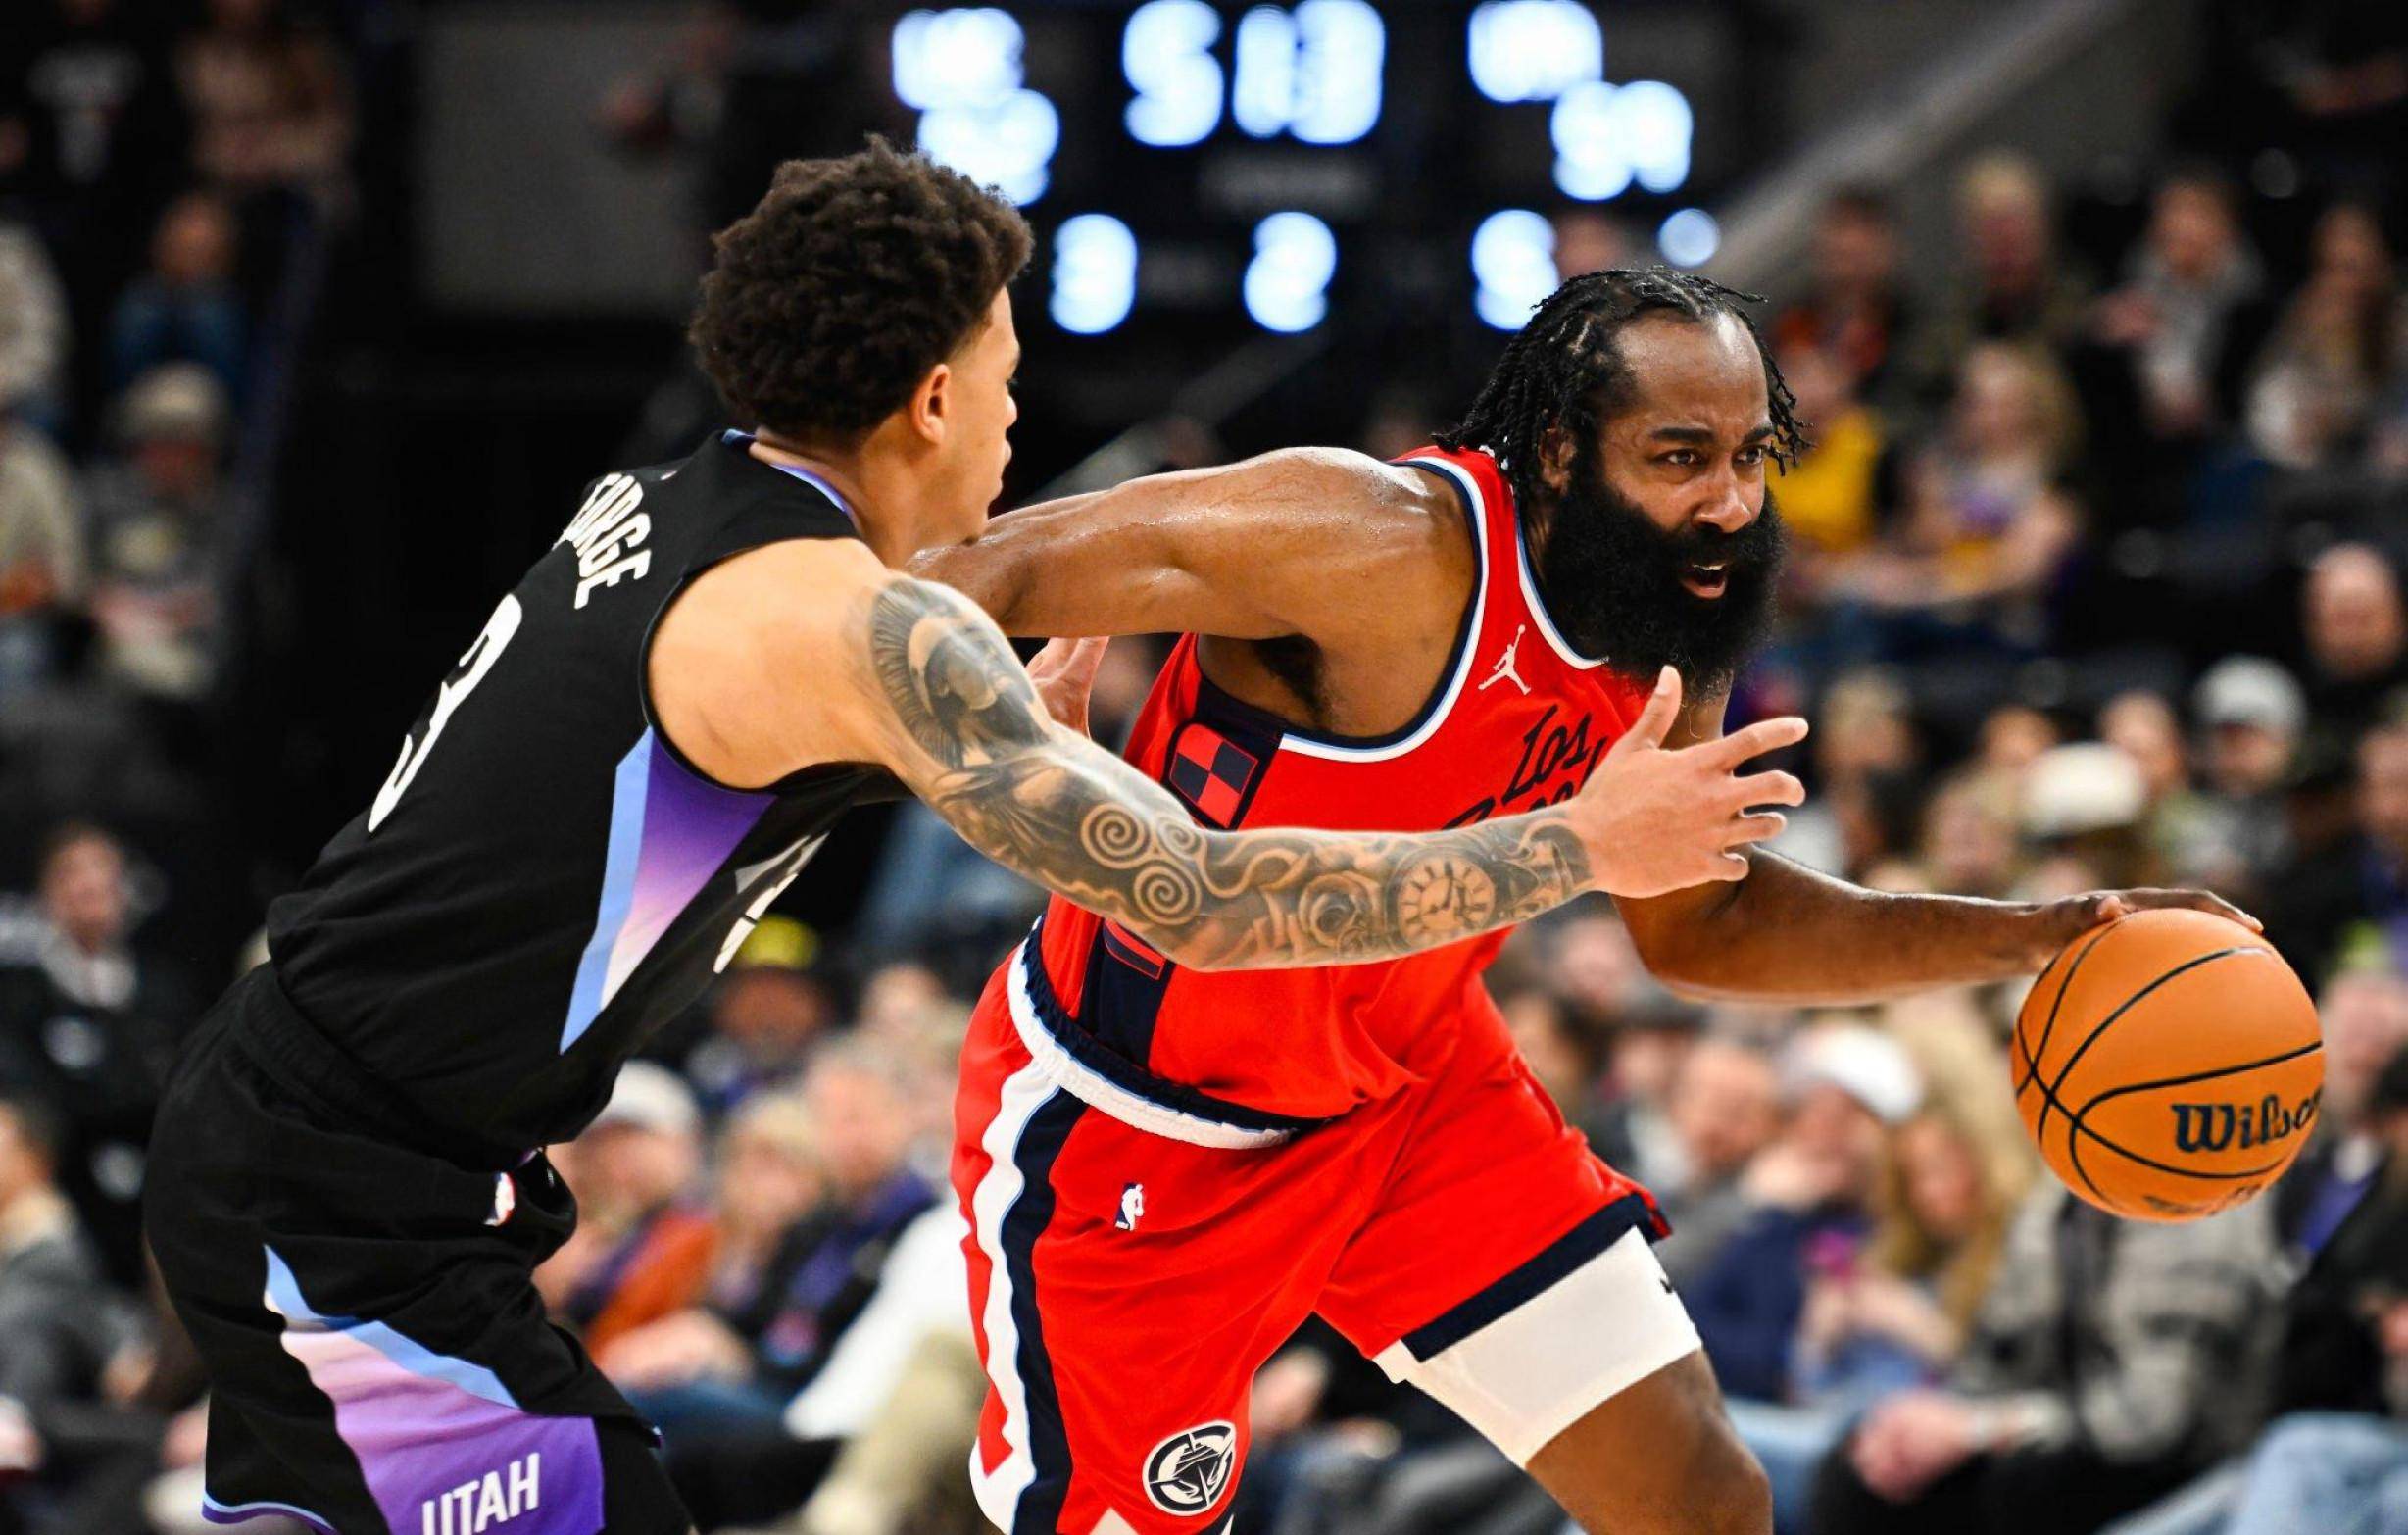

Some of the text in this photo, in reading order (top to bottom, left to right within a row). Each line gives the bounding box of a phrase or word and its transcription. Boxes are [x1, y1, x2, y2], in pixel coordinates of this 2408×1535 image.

[552, 472, 652, 610] EORGE
[1501, 704, 1593, 806] Los
[2171, 1085, 2324, 1154] Wilso
[422, 1452, 540, 1535] UTAH
